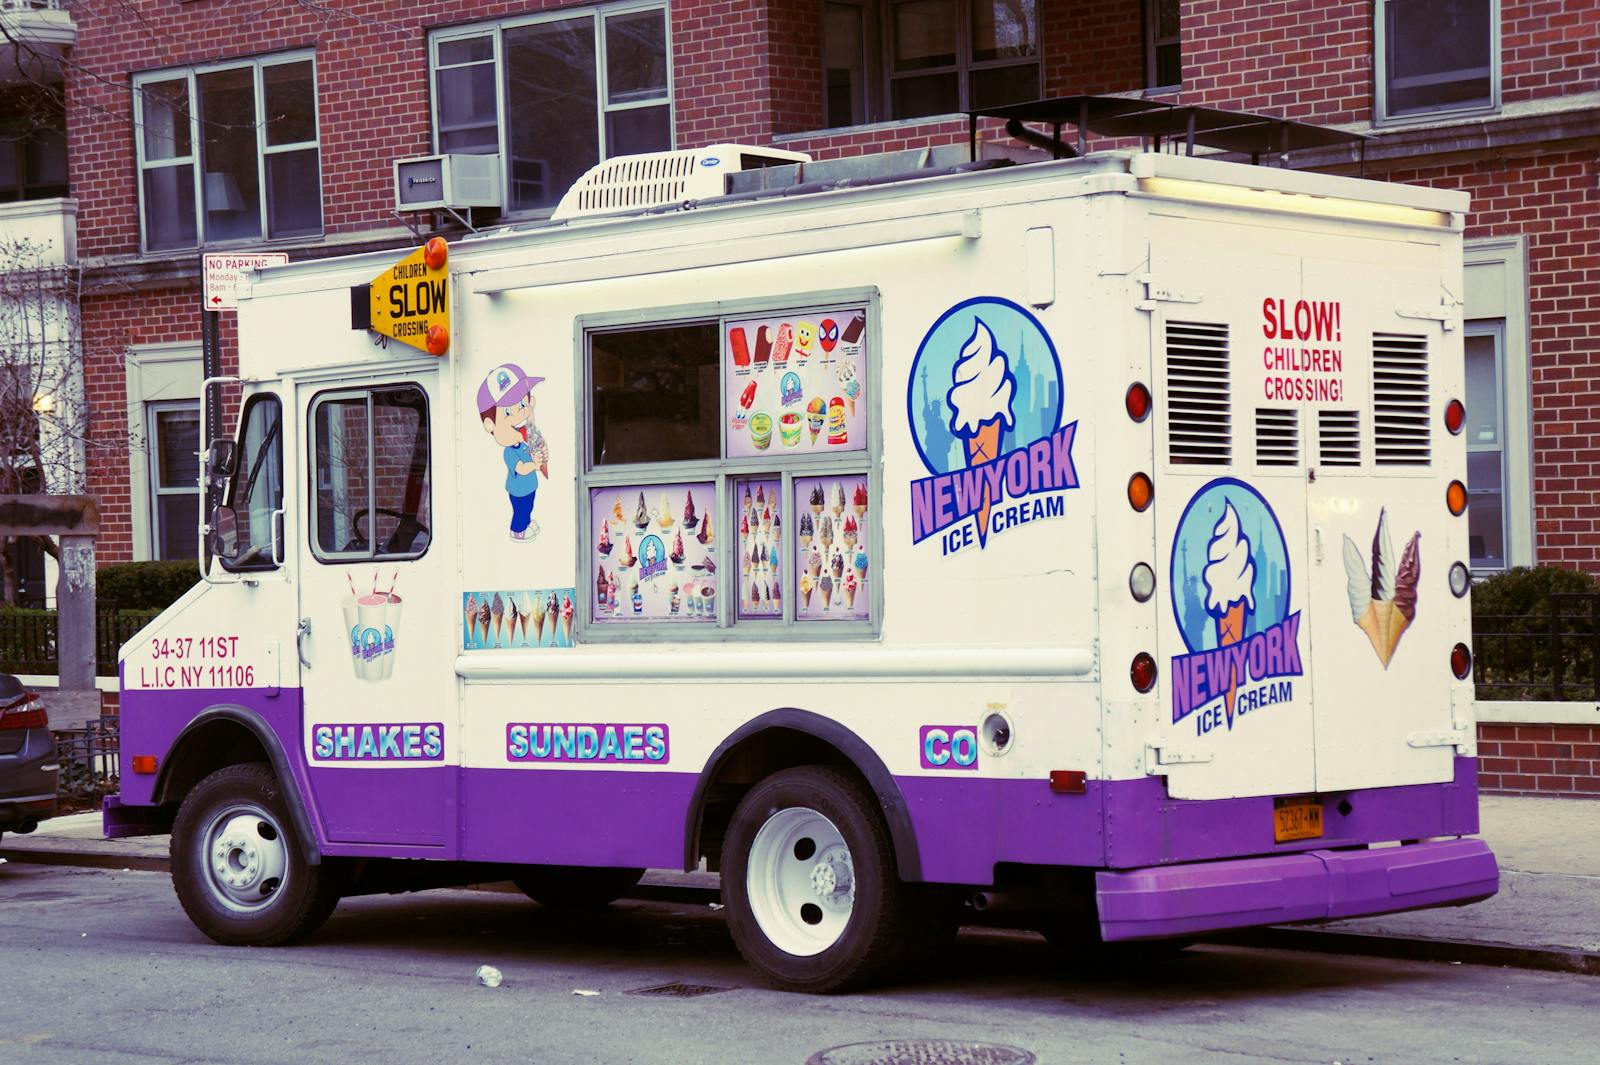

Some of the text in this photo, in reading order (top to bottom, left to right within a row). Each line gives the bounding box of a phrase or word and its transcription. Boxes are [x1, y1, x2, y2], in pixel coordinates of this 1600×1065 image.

[209, 259, 222, 269] NO
[393, 263, 427, 280] CHILDREN
[209, 273, 238, 283] Monday
[209, 283, 226, 291] 8am
[389, 279, 447, 319] SLOW
[393, 320, 429, 337] CROSSING
[1263, 297, 1342, 342] SLOW!
[1263, 346, 1342, 372] CHILDREN
[1265, 376, 1343, 402] CROSSING!
[943, 495, 1064, 556] ICE CREAM
[152, 636, 239, 659] 34-37 11ST
[141, 665, 254, 688] L.I.C NY 11106
[1197, 681, 1292, 736] ICE CREAM
[315, 725, 442, 759] SHAKES
[508, 725, 666, 760] SUNDAES
[925, 728, 977, 766] CO
